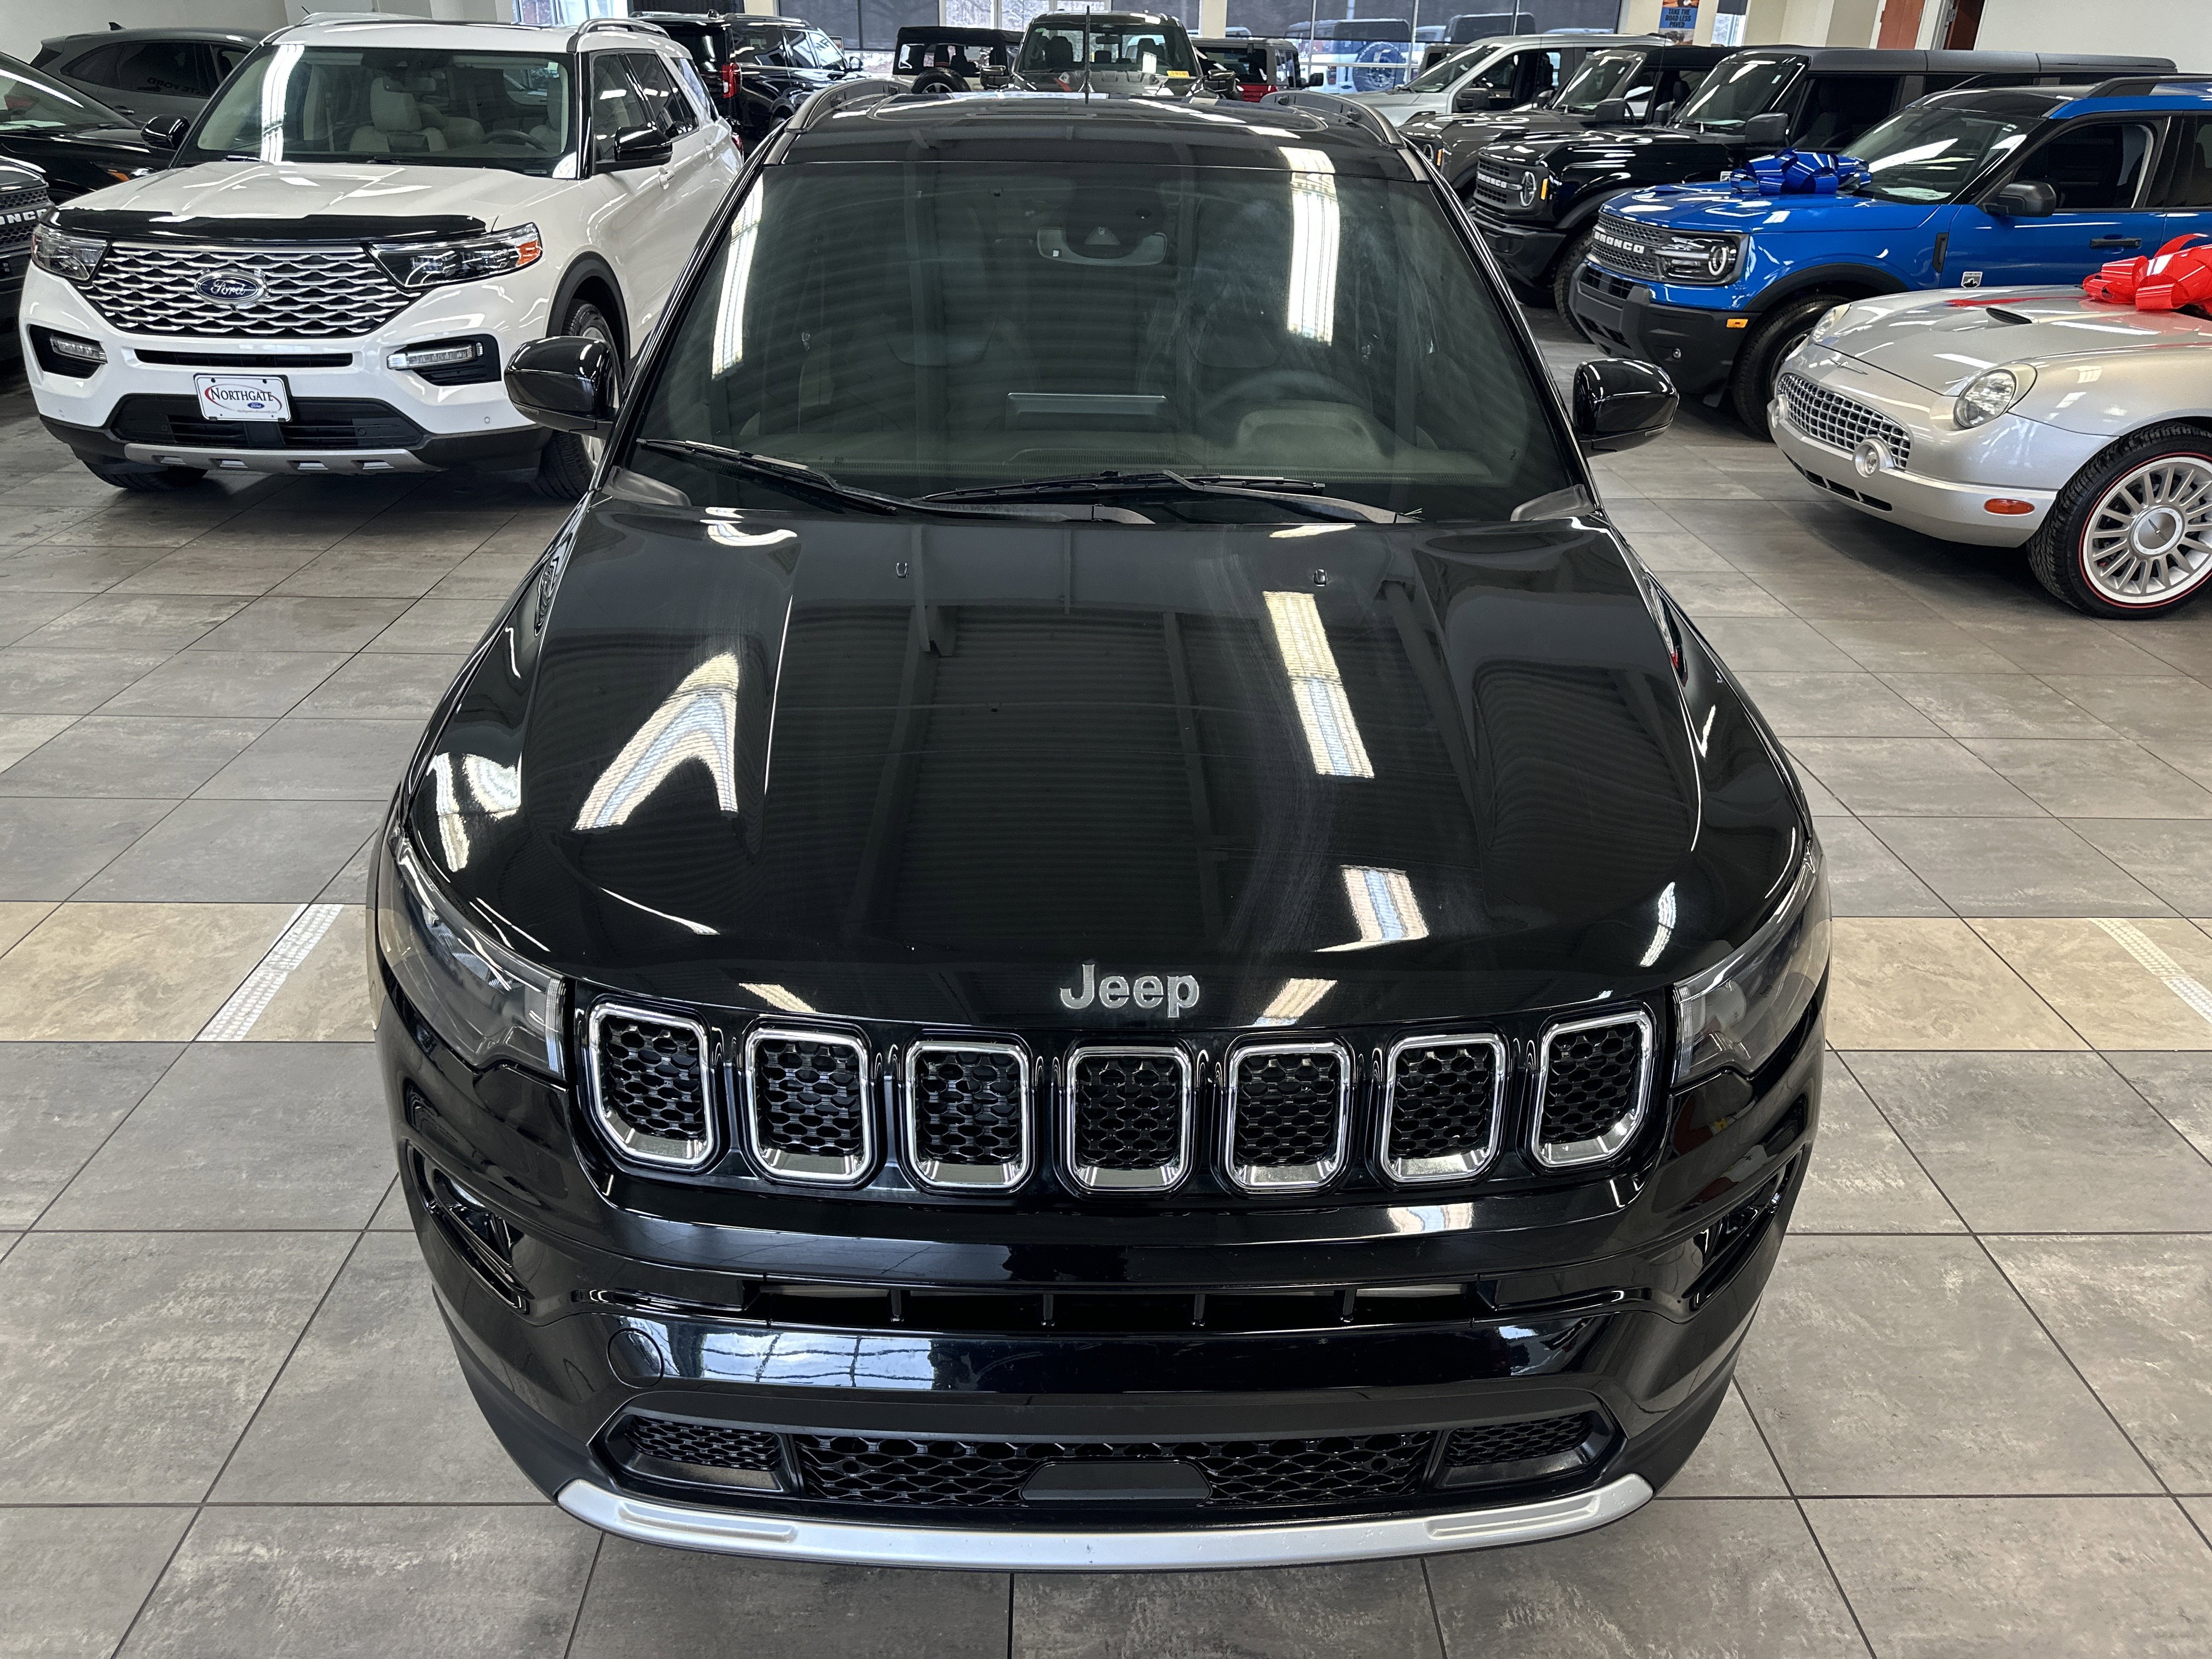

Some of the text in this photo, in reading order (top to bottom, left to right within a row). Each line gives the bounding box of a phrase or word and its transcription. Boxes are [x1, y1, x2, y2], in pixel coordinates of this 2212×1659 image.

[1594, 231, 1645, 254] BRONCO
[210, 279, 246, 295] Ford
[211, 387, 274, 402] NORTHGATE
[1059, 964, 1200, 1018] Jeep
